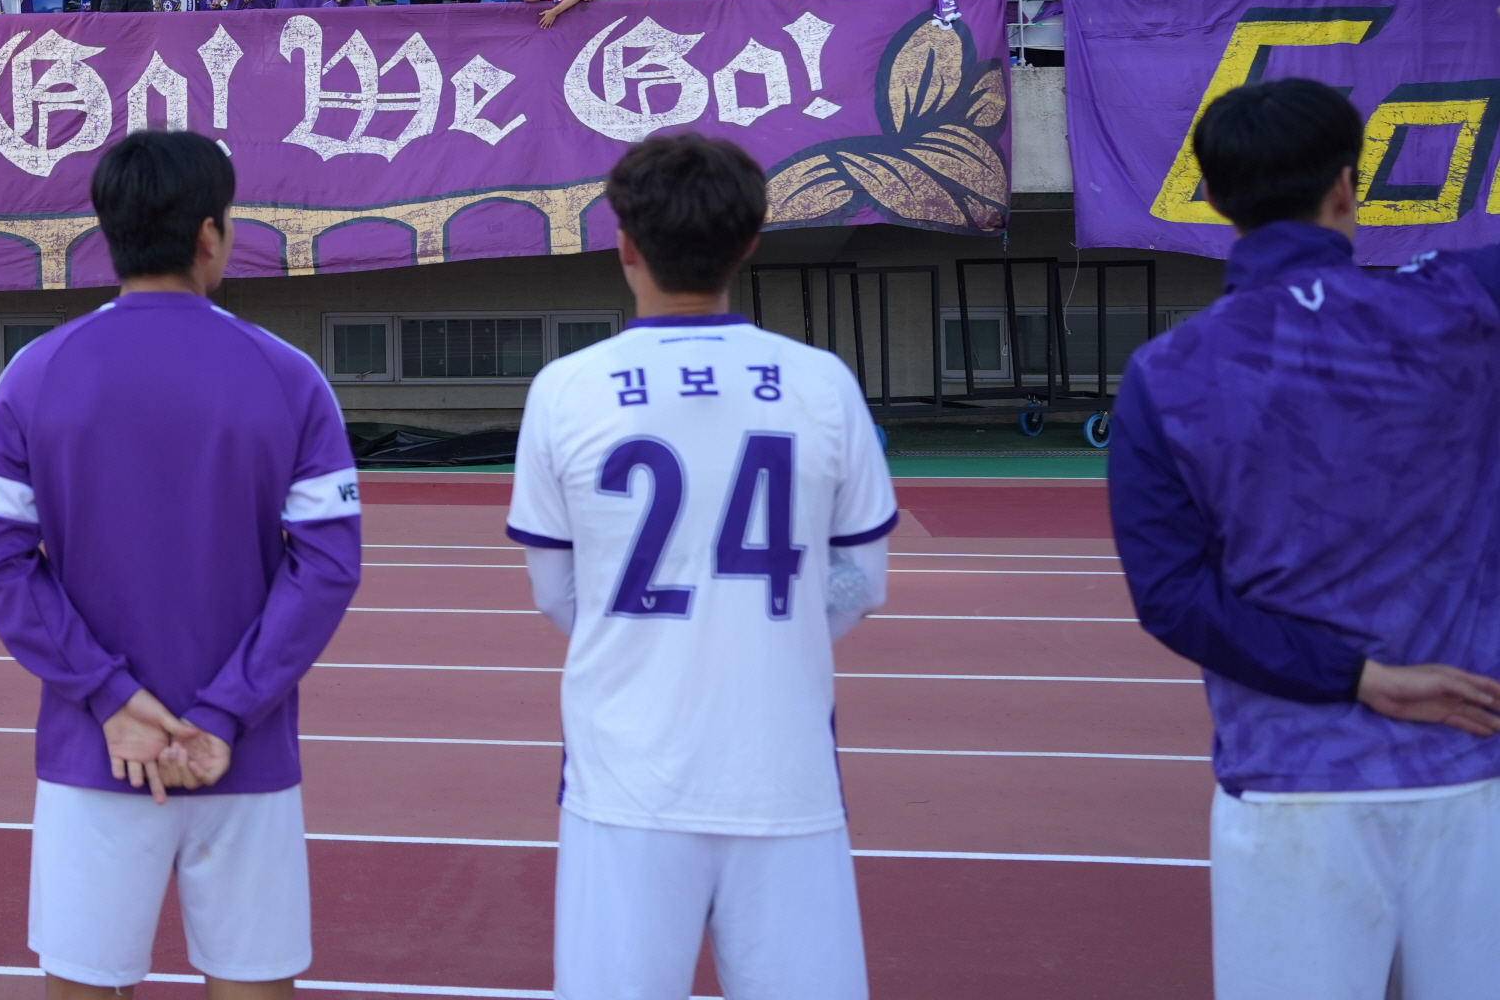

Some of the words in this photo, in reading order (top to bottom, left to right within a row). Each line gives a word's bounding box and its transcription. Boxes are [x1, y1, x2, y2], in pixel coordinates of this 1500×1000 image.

[279, 14, 527, 163] We
[563, 11, 842, 144] Go!
[609, 363, 783, 407] 김보경
[594, 429, 808, 621] 24
